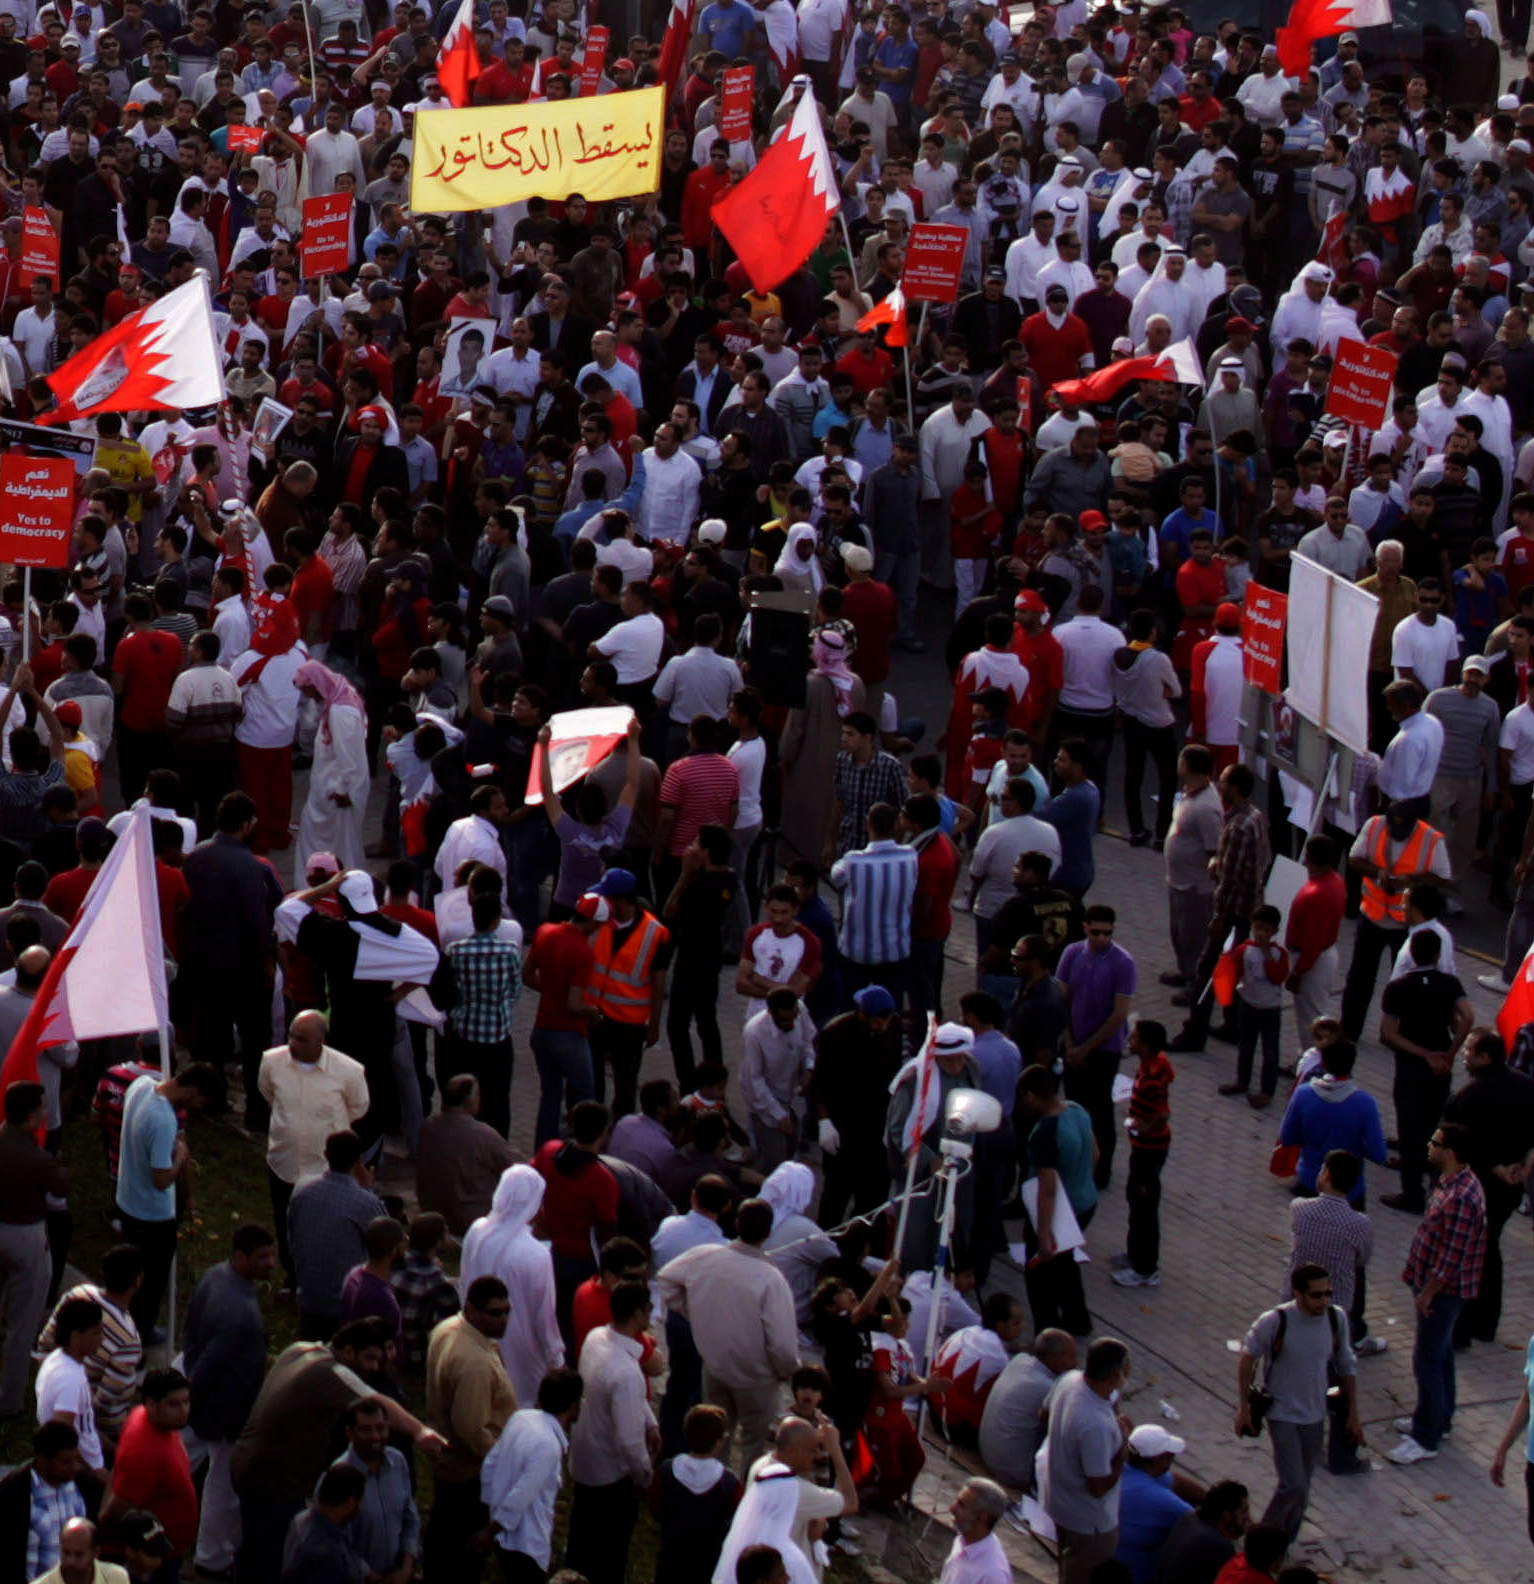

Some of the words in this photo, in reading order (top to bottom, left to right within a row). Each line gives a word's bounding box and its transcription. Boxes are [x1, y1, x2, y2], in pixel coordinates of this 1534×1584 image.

[423, 124, 564, 183] الدكتاتور
[25, 468, 50, 483] نعم
[4, 481, 69, 500] للديمقراطية
[17, 512, 37, 526] Yes
[39, 514, 52, 526] to
[0, 522, 66, 541] democracy
